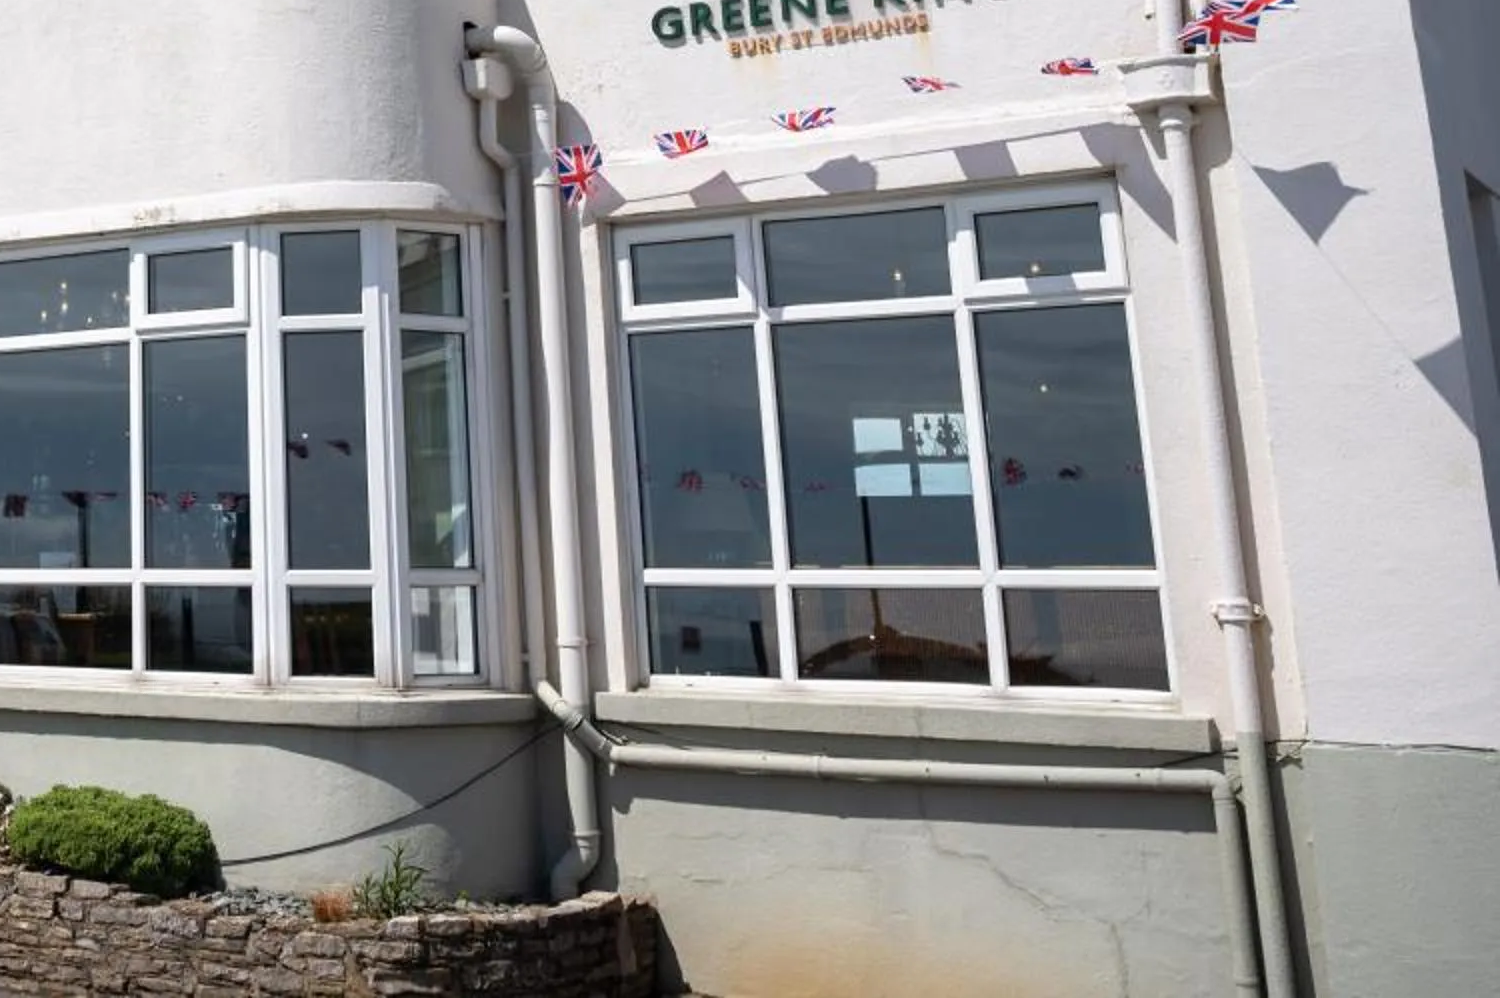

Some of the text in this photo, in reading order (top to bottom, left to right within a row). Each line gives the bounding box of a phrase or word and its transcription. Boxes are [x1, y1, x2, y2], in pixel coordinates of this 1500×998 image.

[728, 13, 931, 58] BURY ST EDMUNDS
